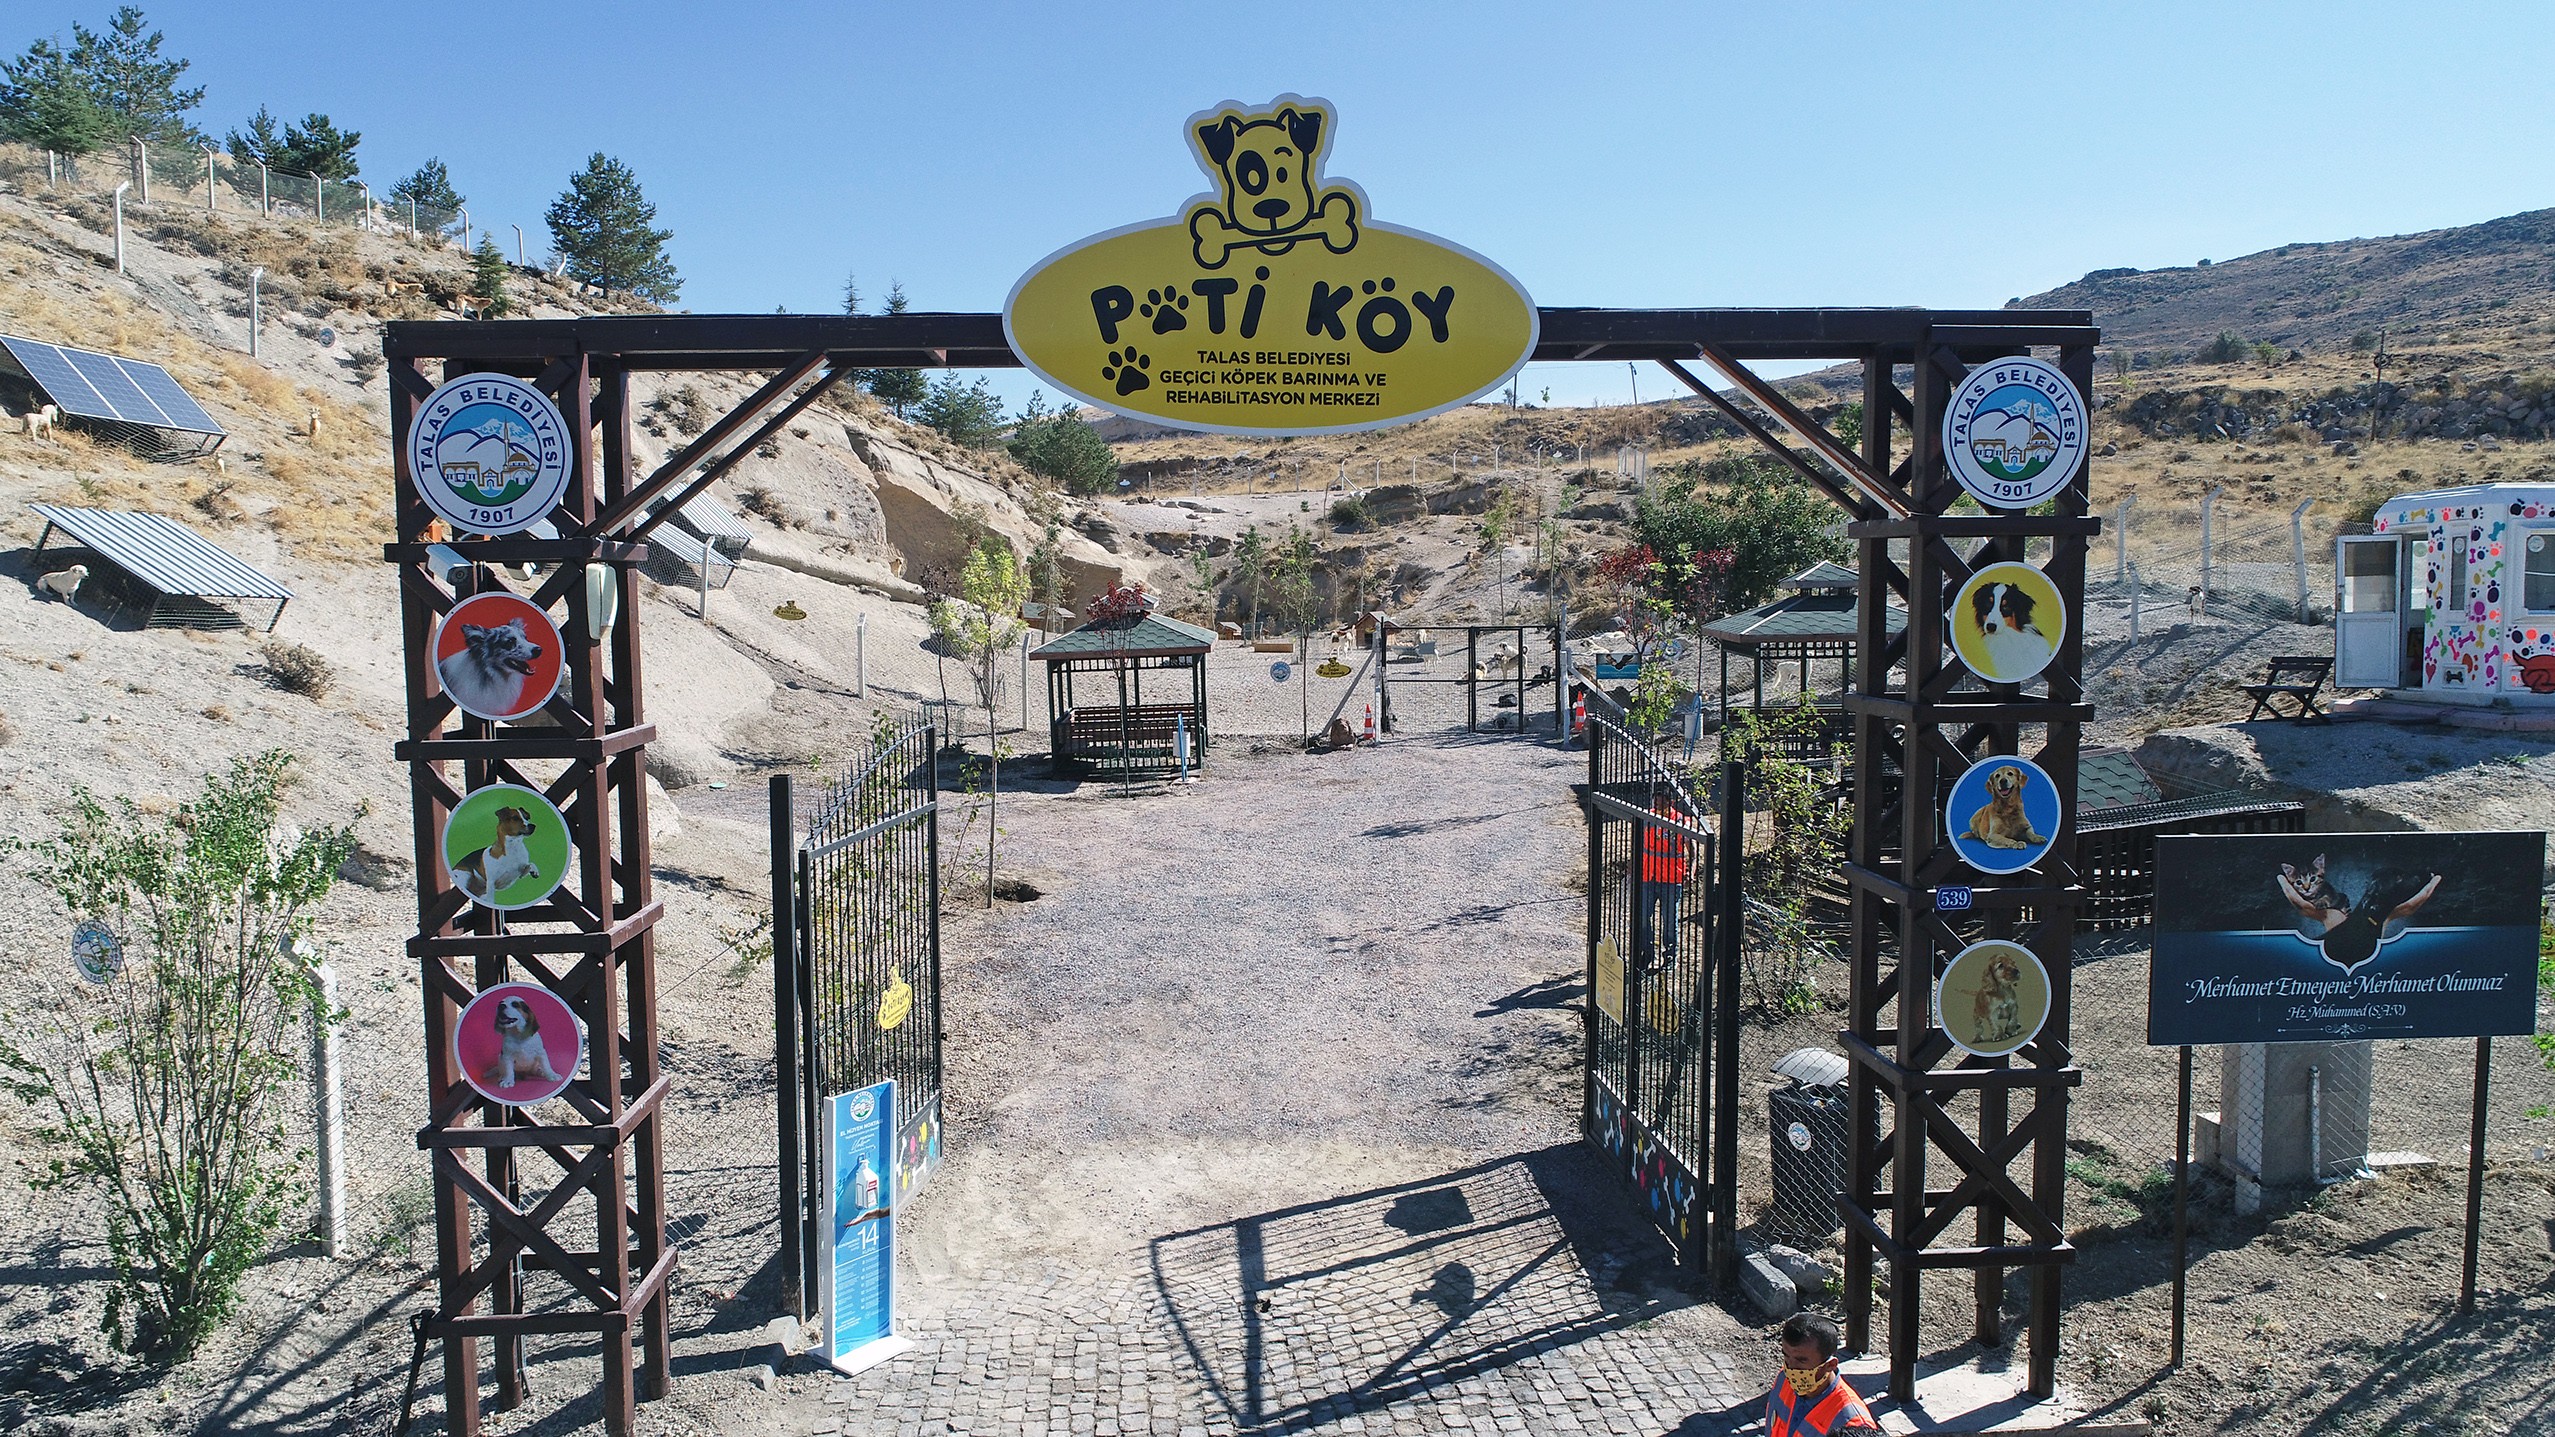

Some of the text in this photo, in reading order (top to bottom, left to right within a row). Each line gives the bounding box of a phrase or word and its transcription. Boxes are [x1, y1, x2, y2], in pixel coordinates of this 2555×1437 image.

[1305, 277, 1455, 354] KÖY
[1197, 350, 1351, 366] TALAS BELEDİYESİ
[1220, 368, 1277, 386] KÖPEK
[1282, 371, 1360, 387] BARINMA
[1364, 372, 1387, 387] VE
[1309, 392, 1380, 407] MERKEZİ
[1954, 369, 2078, 449] TALAS BELEDİYESİ
[420, 387, 561, 473] TALAS BELEDİYESİ
[1993, 482, 2033, 497] 1907
[469, 506, 514, 523] 1907
[1940, 890, 1968, 907] 539
[2275, 977, 2352, 1004] Etmeyene
[2348, 971, 2436, 1000] Merhamet
[857, 1221, 879, 1250] 14
